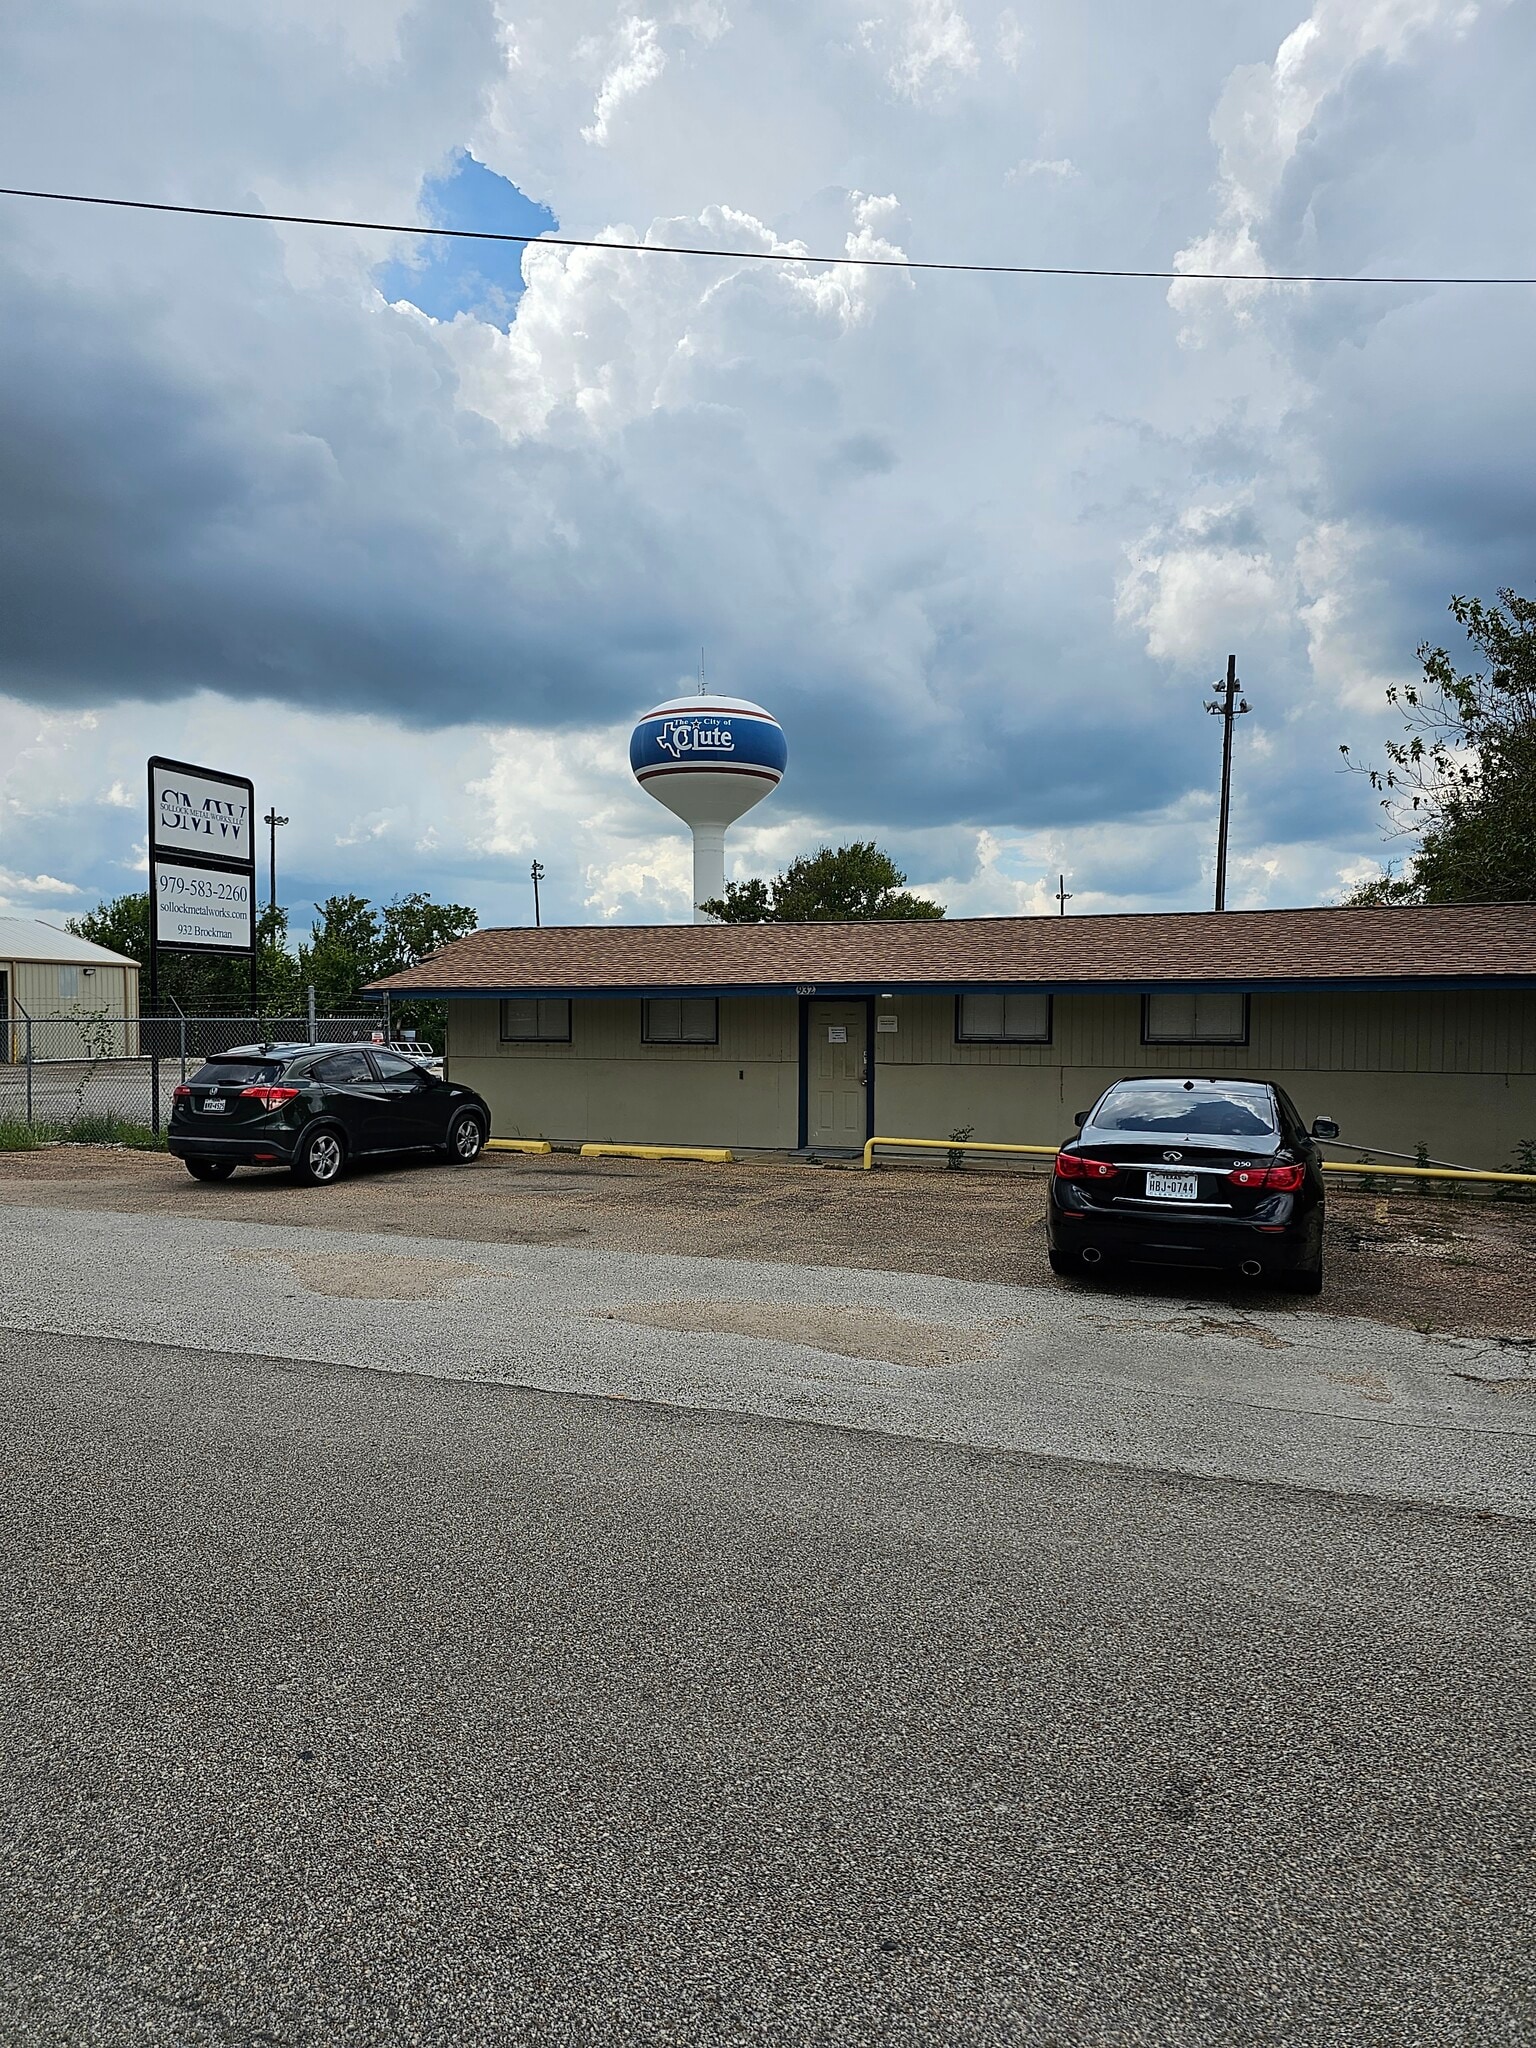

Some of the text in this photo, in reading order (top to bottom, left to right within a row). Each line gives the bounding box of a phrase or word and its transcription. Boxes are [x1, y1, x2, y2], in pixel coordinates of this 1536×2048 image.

[703, 718, 721, 726] City
[672, 725, 735, 751] Clute
[160, 802, 190, 816] SOLLOCK
[189, 808, 211, 820] METAL
[161, 789, 248, 840] SMW
[160, 875, 248, 903] 979-583-2260
[160, 901, 248, 920] sollockmetalworks.com
[177, 924, 233, 939] 932 Brockman
[797, 985, 816, 995] 932
[1233, 1160, 1252, 1168] Q50
